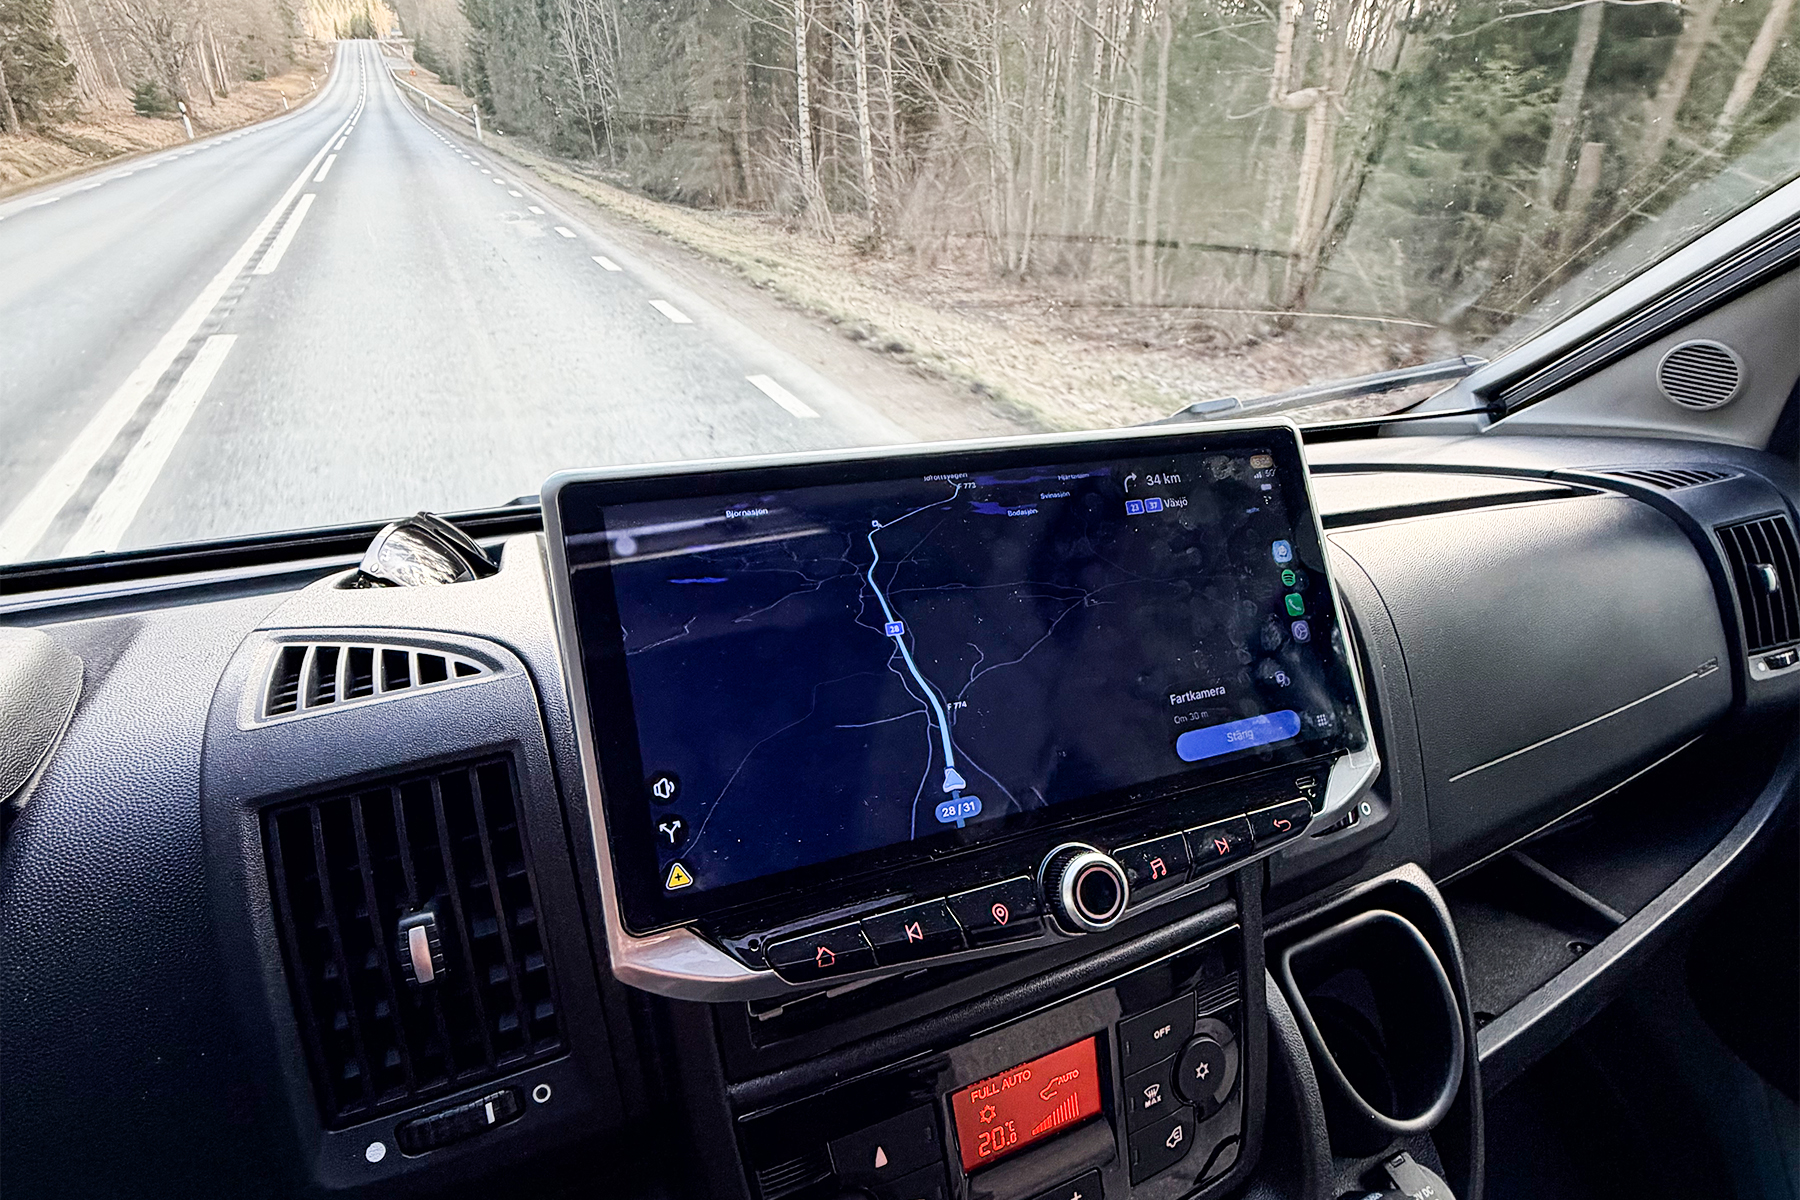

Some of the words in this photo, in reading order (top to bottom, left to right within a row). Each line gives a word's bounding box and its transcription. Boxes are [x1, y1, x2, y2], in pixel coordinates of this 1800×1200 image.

[1145, 473, 1161, 486] 34
[1162, 472, 1181, 484] km
[1163, 496, 1188, 508] Växjö
[1169, 686, 1226, 705] Fartkamera
[953, 700, 967, 709] 774
[1173, 715, 1188, 725] Om
[1189, 711, 1200, 722] 30
[1201, 710, 1209, 719] m
[1153, 1024, 1171, 1040] OFF
[1057, 1069, 1080, 1086] AUTO
[970, 1083, 1000, 1104] FULL
[1001, 1069, 1032, 1091] AUTO
[1144, 1094, 1162, 1109] MAX
[1422, 1185, 1435, 1198] DC
